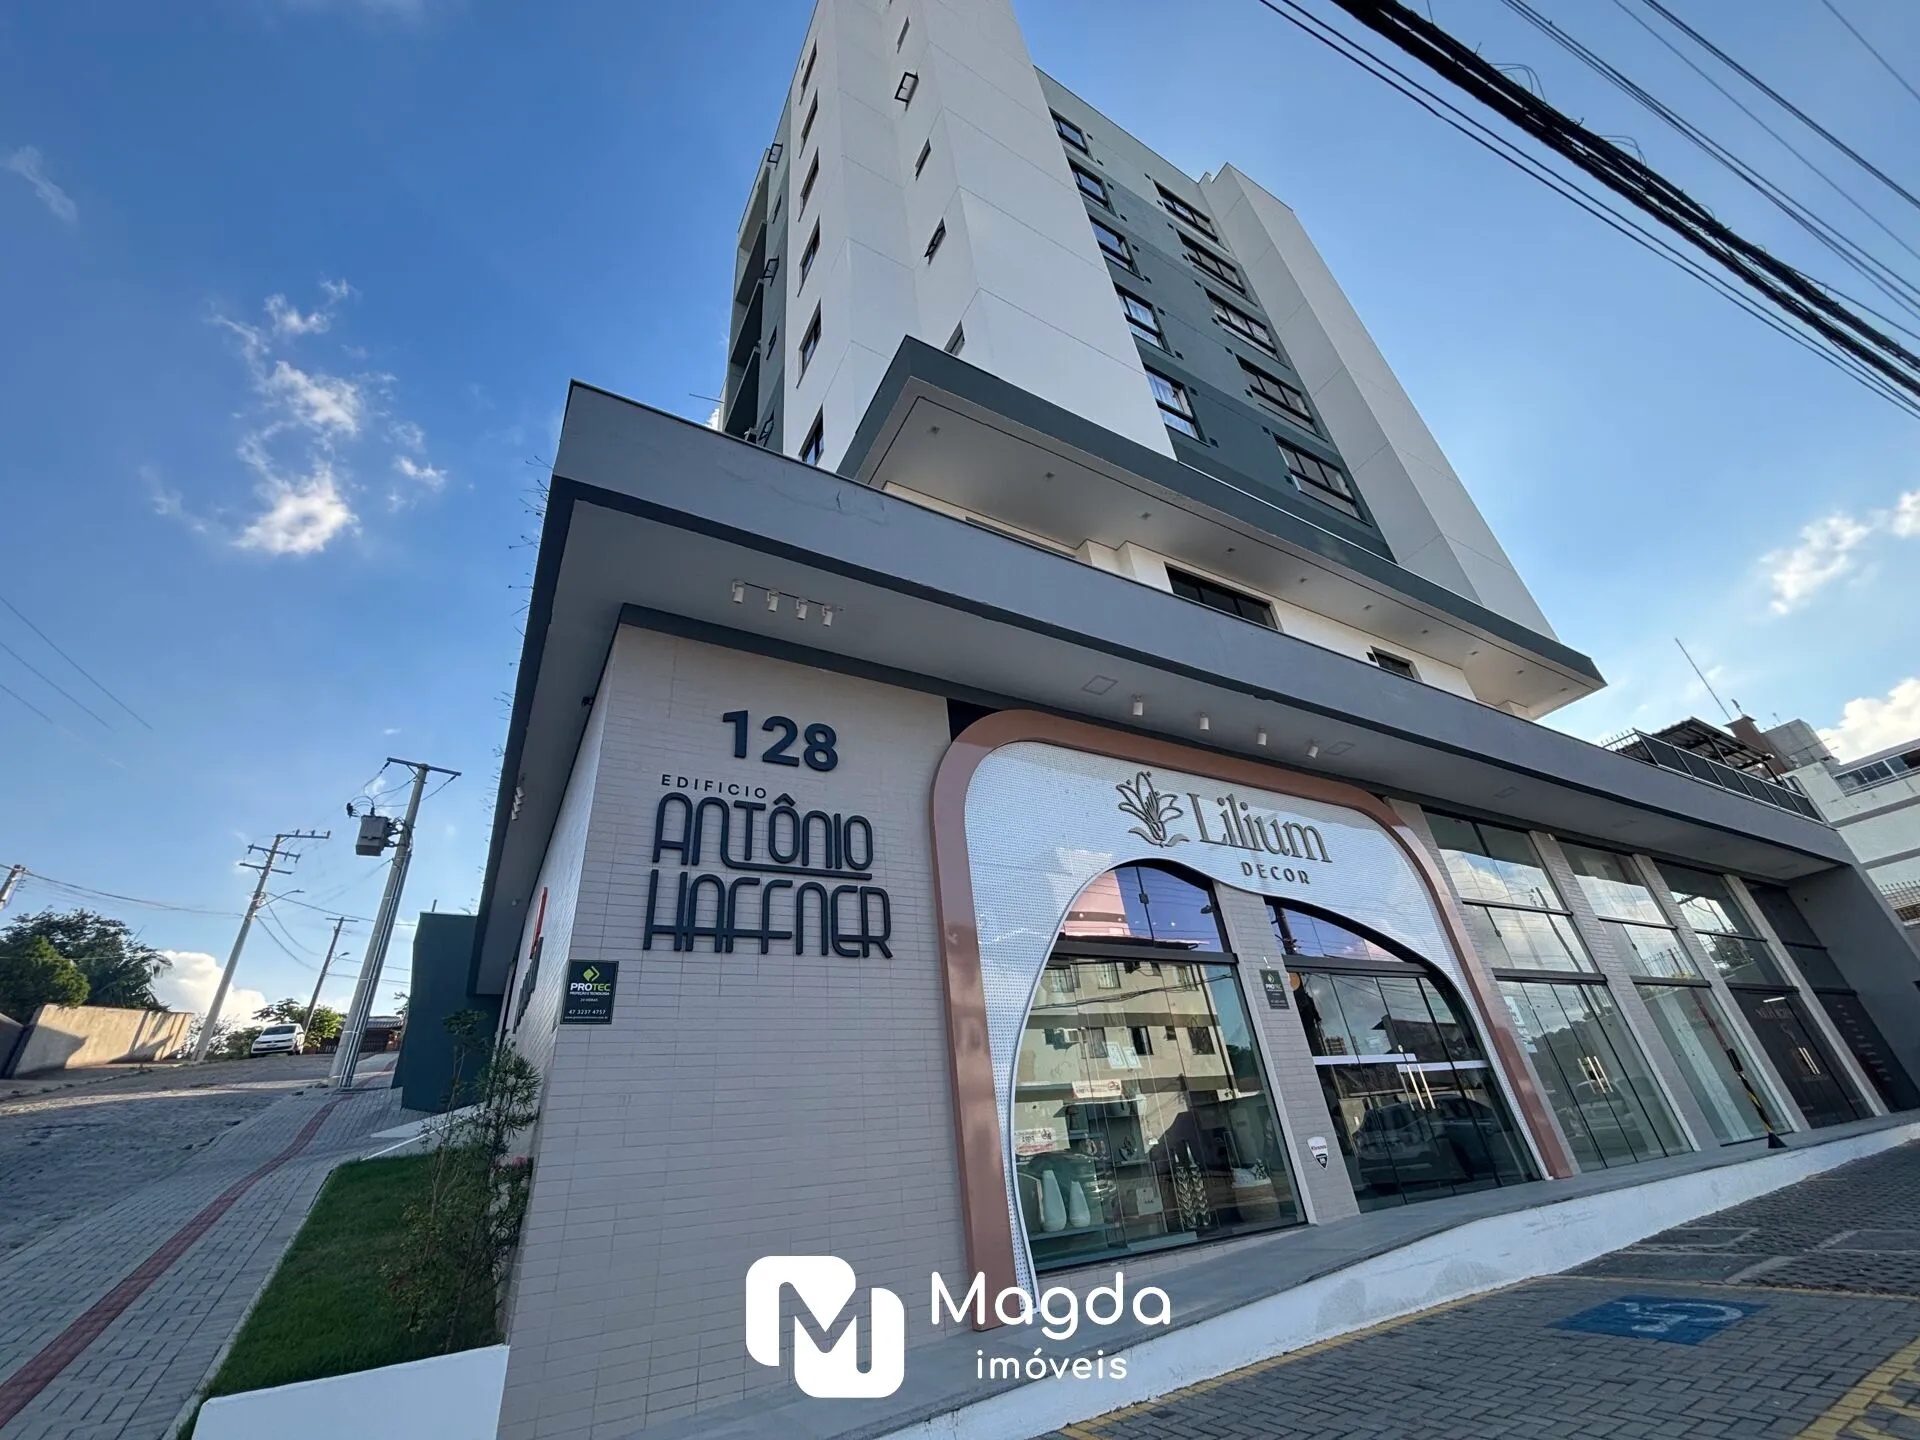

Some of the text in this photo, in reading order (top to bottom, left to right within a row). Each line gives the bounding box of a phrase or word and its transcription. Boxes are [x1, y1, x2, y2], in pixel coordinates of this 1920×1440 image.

[722, 710, 838, 771] 128
[660, 774, 767, 799] EDIFICIO
[652, 792, 873, 880] ANTÔNIO
[1186, 793, 1333, 863] Lilium
[1241, 861, 1311, 884] DECOR
[642, 869, 893, 958] HAFFNER
[570, 983, 610, 991] PROTEC
